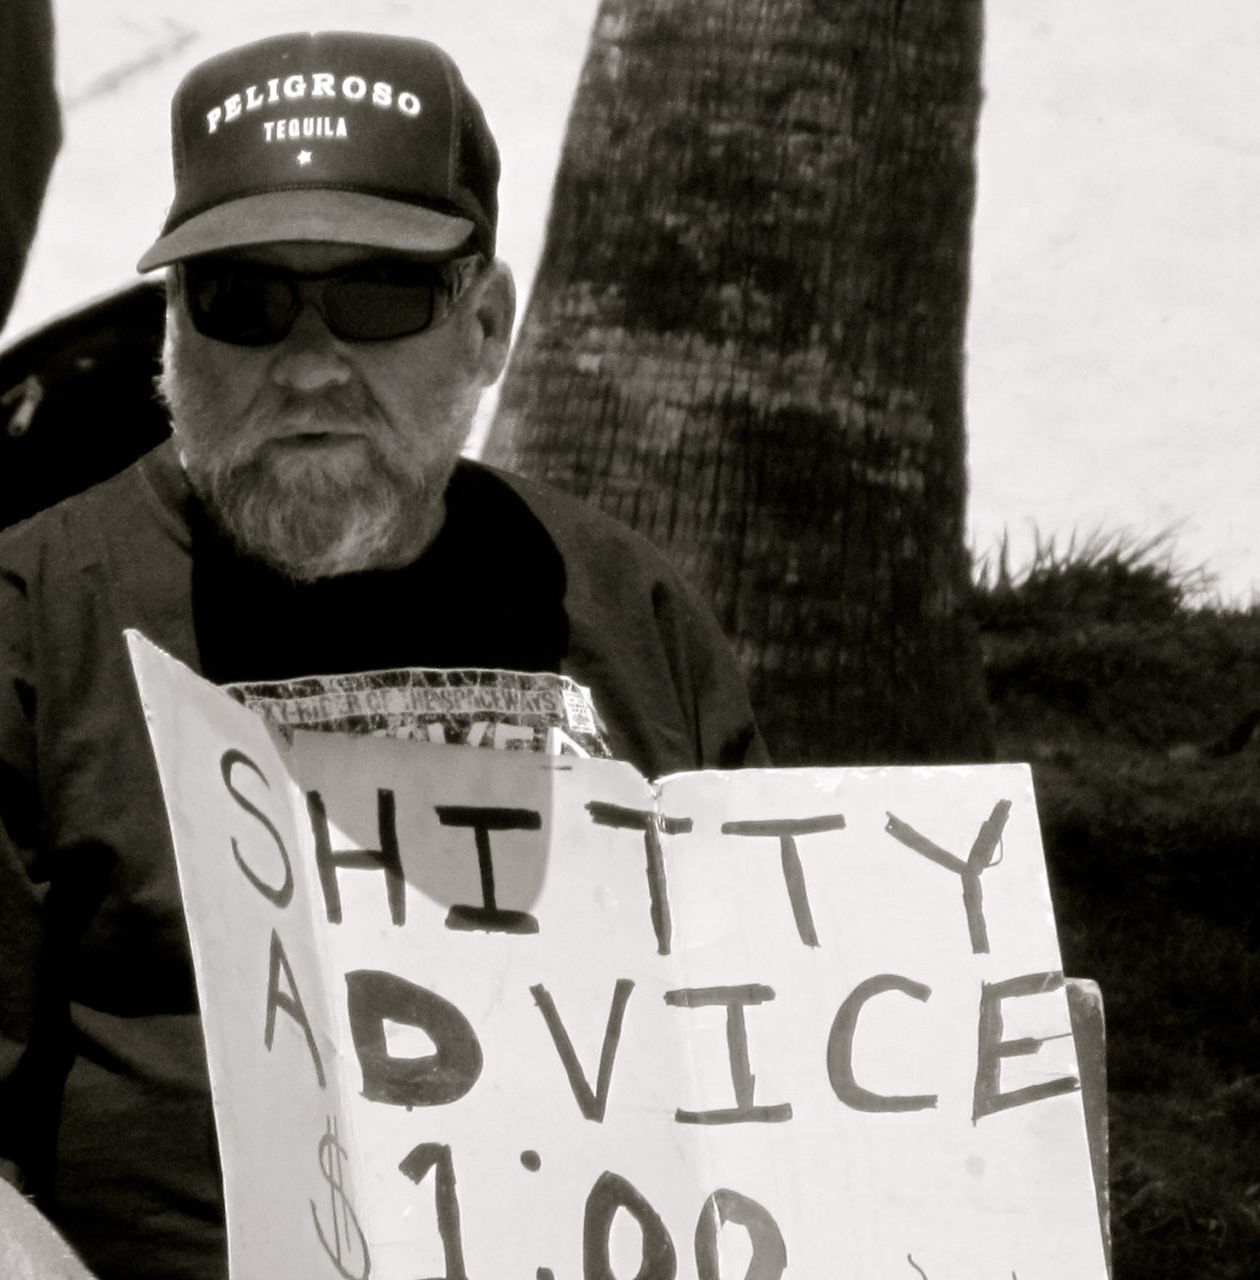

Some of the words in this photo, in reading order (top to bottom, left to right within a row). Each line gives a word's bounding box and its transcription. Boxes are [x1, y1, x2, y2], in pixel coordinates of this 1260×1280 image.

[205, 72, 422, 134] PELIGROSO
[263, 116, 348, 141] TEQUILA
[220, 748, 1012, 956] SHITTY
[263, 927, 1082, 1128] ADVICE
